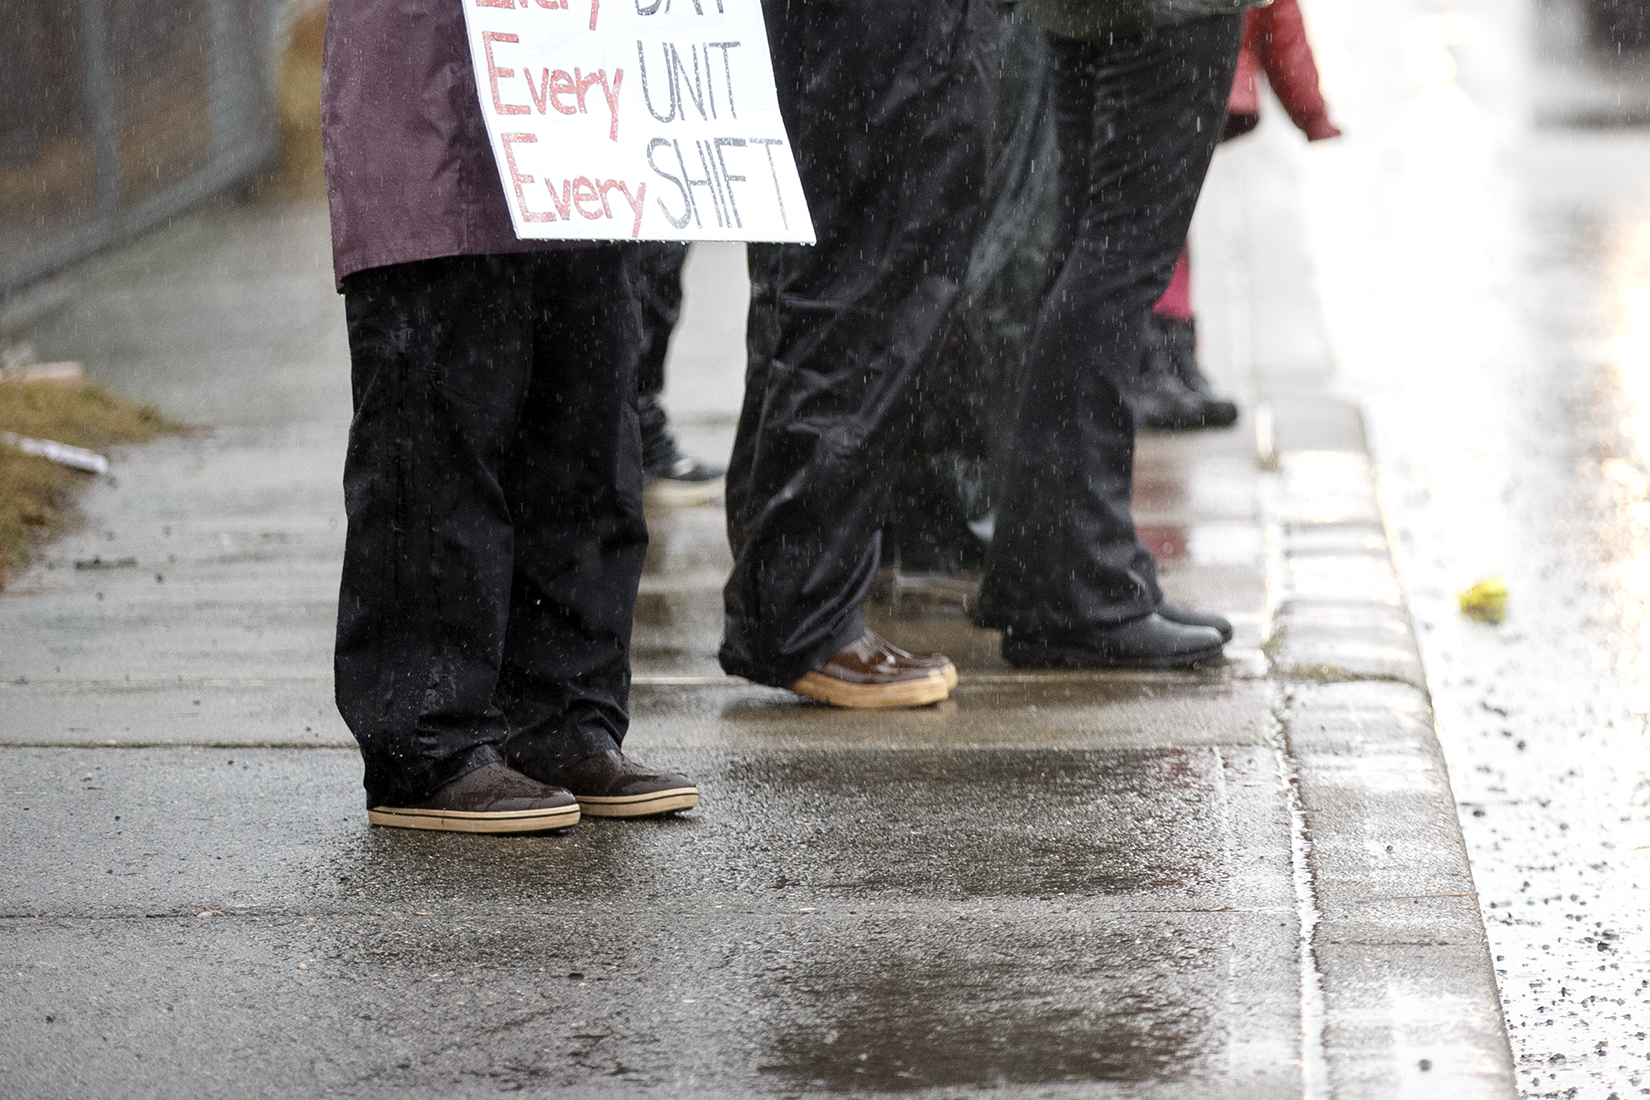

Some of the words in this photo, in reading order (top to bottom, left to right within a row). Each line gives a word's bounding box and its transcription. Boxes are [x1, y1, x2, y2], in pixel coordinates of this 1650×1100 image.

[482, 31, 624, 142] Every
[636, 40, 741, 123] UNIT
[500, 132, 647, 238] Every
[646, 137, 789, 231] SHIFT
